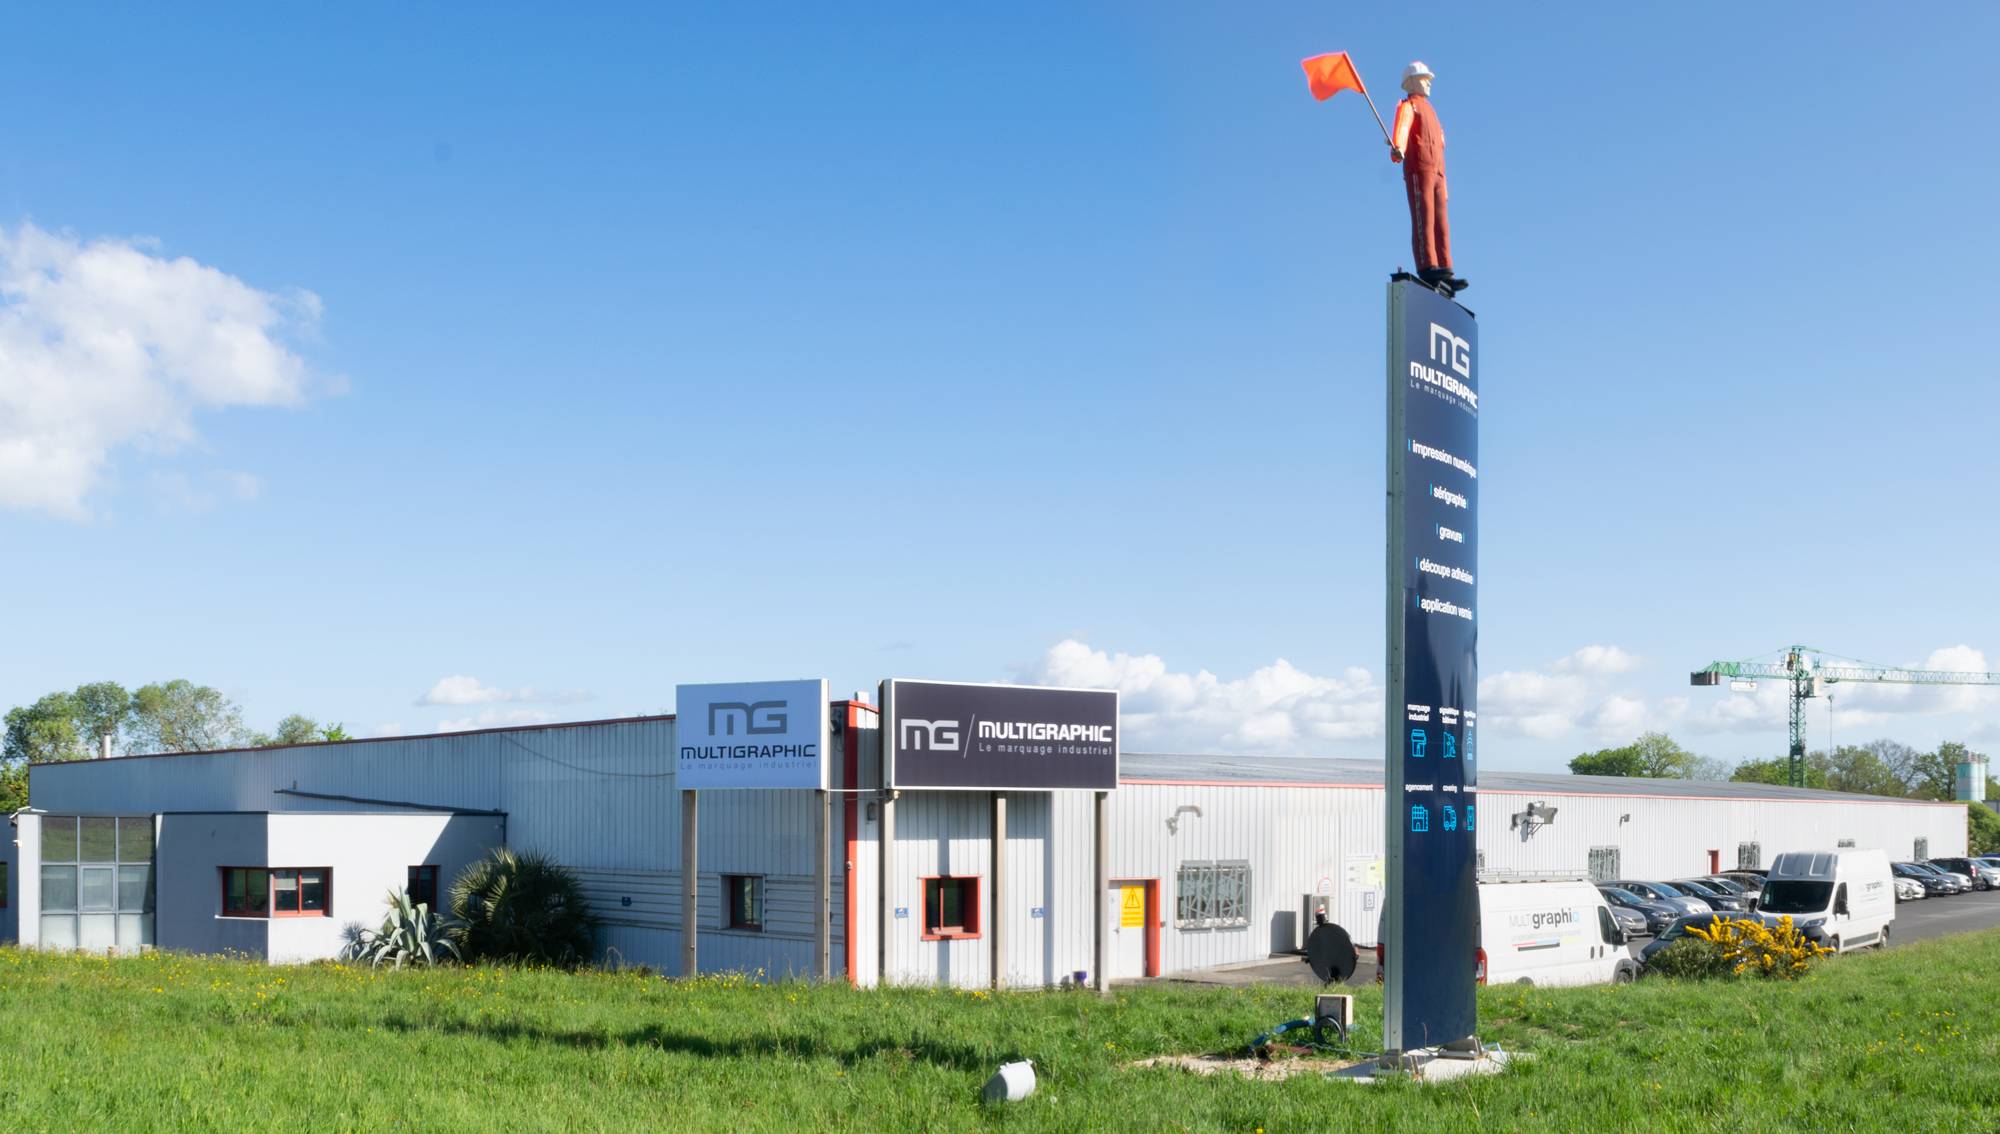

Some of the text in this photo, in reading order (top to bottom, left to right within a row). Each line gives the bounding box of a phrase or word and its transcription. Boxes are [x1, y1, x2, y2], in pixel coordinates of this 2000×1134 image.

[1430, 322, 1469, 379] MG
[1410, 379, 1421, 390] Le
[1410, 361, 1478, 409] MULTIGRAPHIC
[1412, 439, 1453, 465] impression
[1439, 526, 1463, 543] gravure
[1419, 558, 1451, 579] découpe
[1420, 598, 1458, 617] application
[708, 700, 788, 736] MG
[900, 718, 960, 751] MG
[978, 720, 1113, 743] MULTIGRAPHIC
[680, 744, 817, 760] MULTIGRAPHIC
[978, 743, 1113, 756] Le marquage industriel
[680, 760, 817, 771] Le marquage industriel
